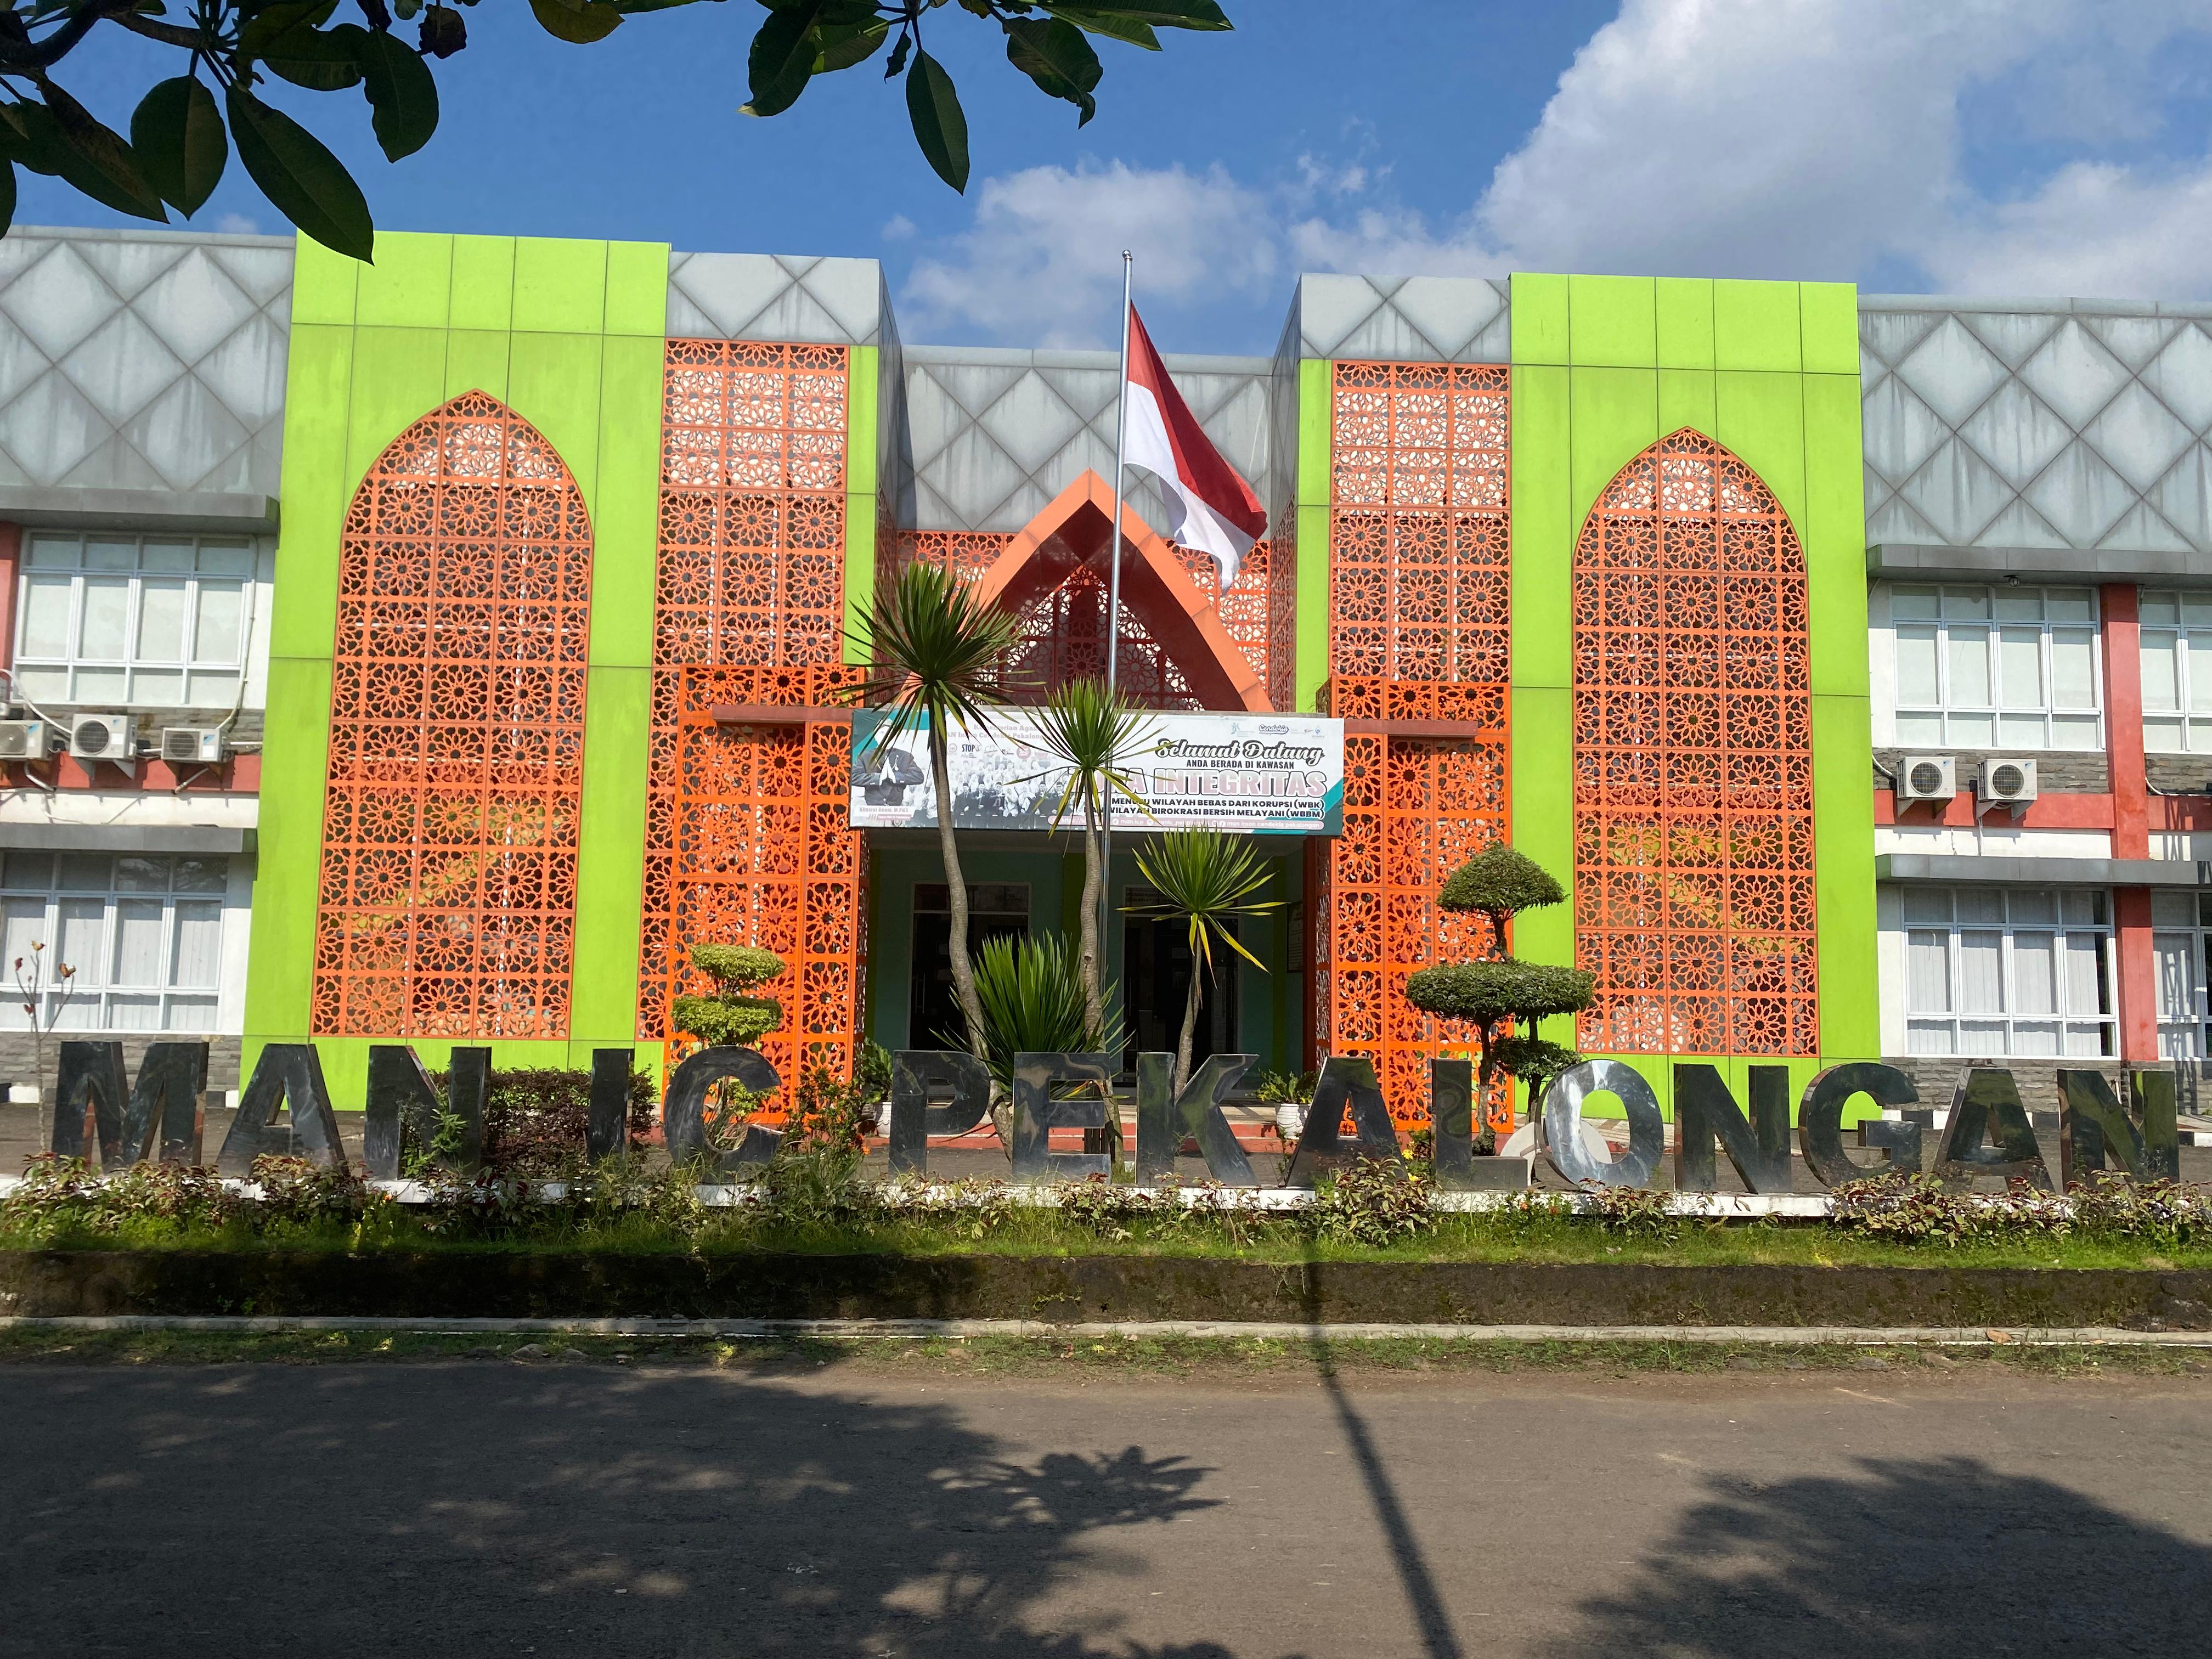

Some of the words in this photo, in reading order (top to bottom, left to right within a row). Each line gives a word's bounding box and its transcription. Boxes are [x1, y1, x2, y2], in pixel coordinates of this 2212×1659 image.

[962, 744, 975, 752] STOP
[1155, 738, 1240, 758] Selamat
[1242, 740, 1325, 766] Datang
[1153, 768, 1327, 798] INTEGRITAS
[1294, 799, 1324, 809] (WBK)
[1286, 809, 1324, 819] (WBBM)
[52, 1041, 493, 1180] MAN
[587, 1046, 783, 1183] IC
[888, 1049, 2180, 1195] PEKALONGAN
